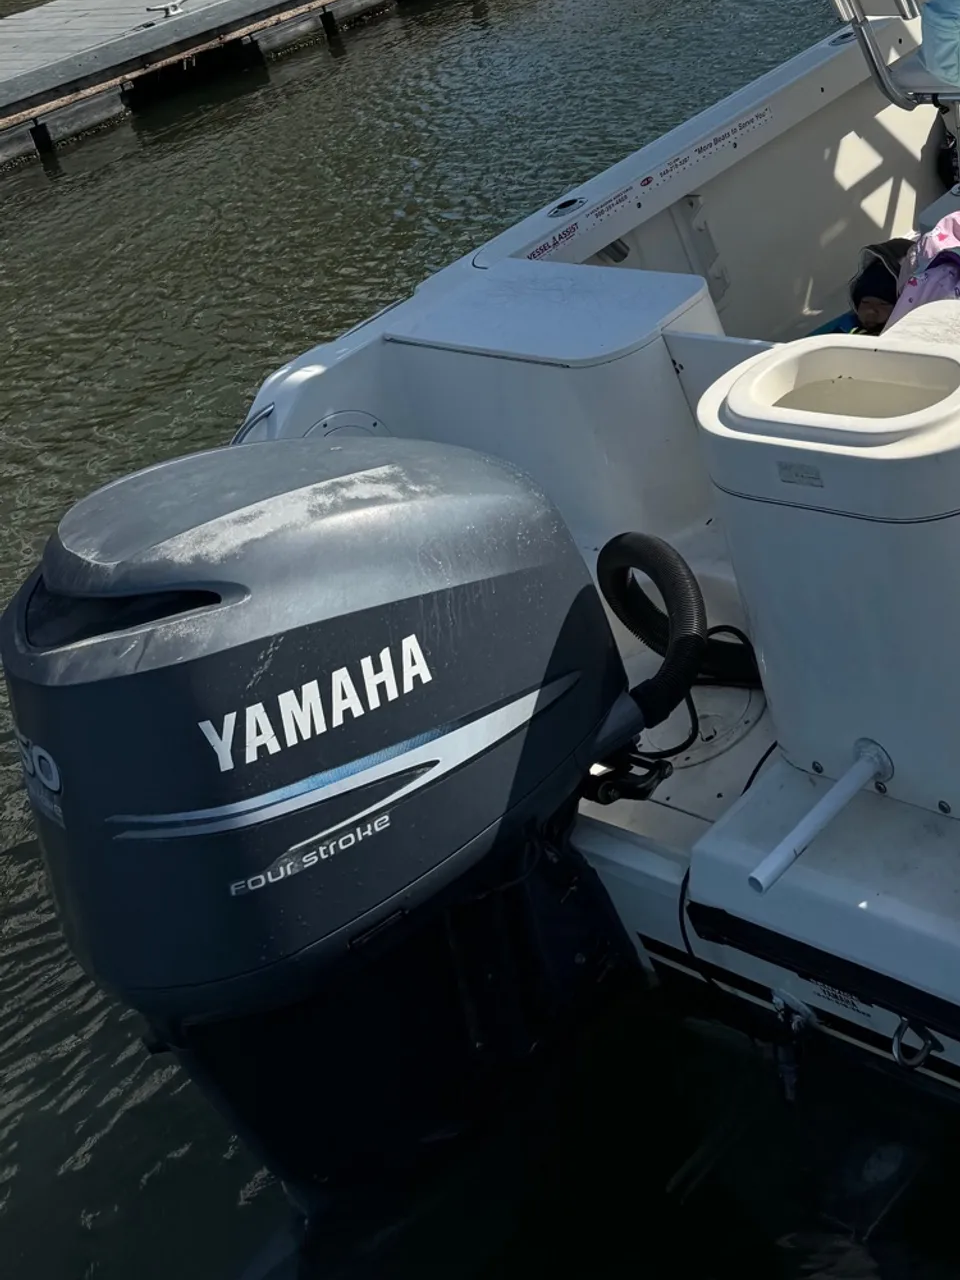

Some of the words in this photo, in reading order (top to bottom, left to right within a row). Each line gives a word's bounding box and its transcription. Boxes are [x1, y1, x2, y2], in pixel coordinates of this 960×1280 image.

[527, 242, 551, 260] VESSEL
[558, 222, 579, 241] ASSIST
[198, 634, 433, 772] YAMAHA
